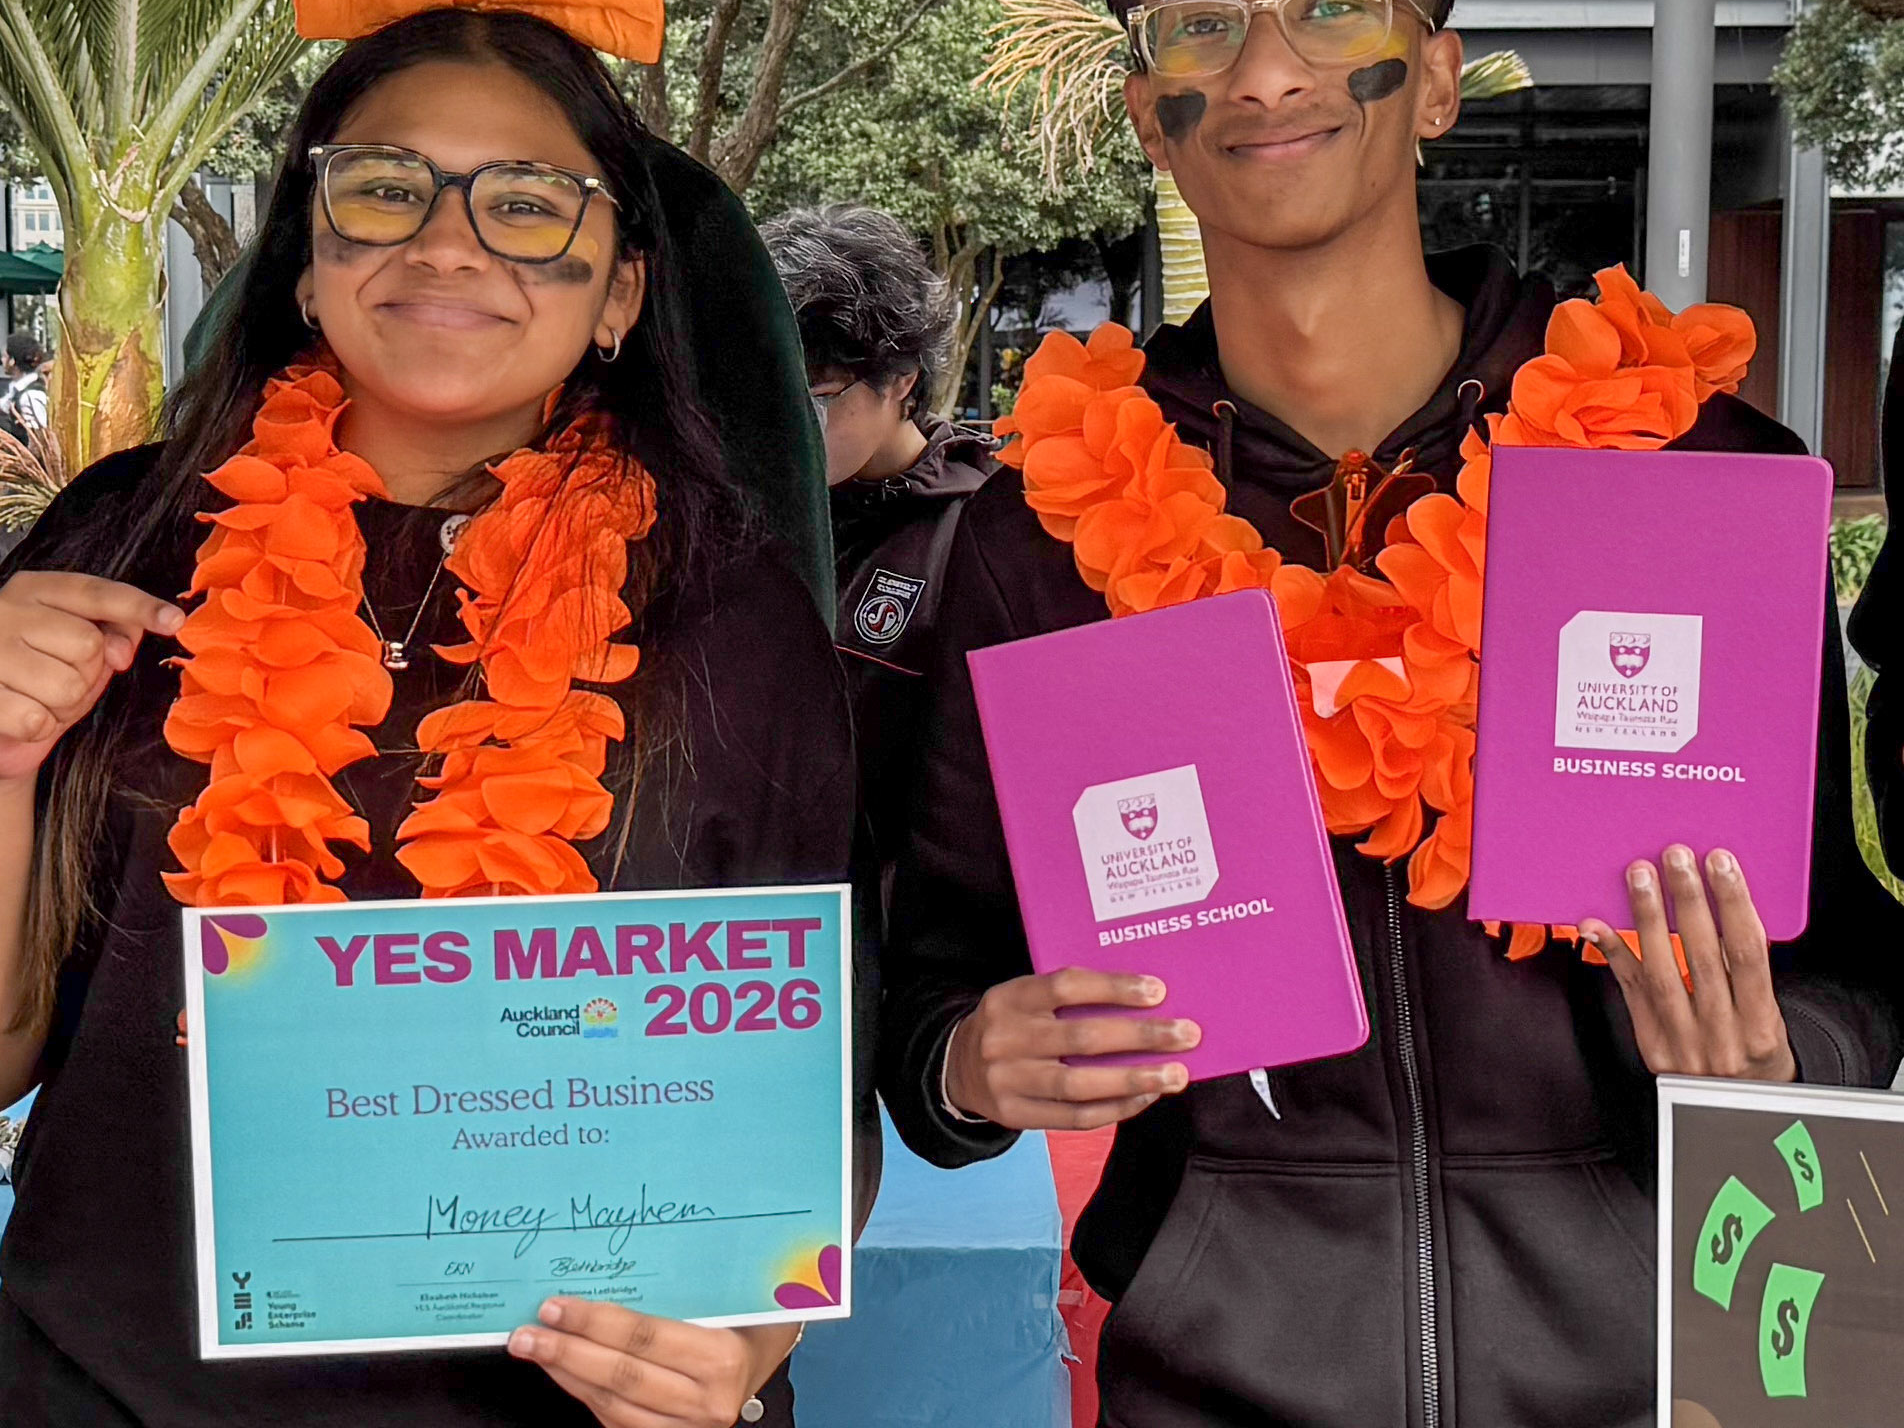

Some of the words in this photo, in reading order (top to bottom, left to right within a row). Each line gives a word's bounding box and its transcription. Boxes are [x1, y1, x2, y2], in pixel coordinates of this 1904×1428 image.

[1577, 682, 1657, 696] UNIVERSITY
[1661, 686, 1679, 697] OF
[1577, 696, 1678, 713] AUCKLAND
[1553, 758, 1656, 777] BUSINESS
[1661, 763, 1746, 782] SCHOOL
[1101, 838, 1173, 865] UNIVERSITY
[1177, 836, 1192, 848] OF
[1106, 849, 1196, 880] AUCKLAND
[1098, 914, 1193, 947] BUSINESS
[1196, 898, 1274, 926] SCHOOL
[313, 930, 472, 987] YES
[493, 917, 822, 982] MARKET
[499, 1004, 580, 1024] Auckland
[644, 978, 822, 1037] 2026
[515, 1020, 581, 1039] Council
[325, 1086, 399, 1120] Best
[412, 1079, 555, 1115] Dressed
[566, 1073, 715, 1108] Business
[452, 1124, 569, 1151] Awarded
[578, 1125, 610, 1146] to:
[426, 1194, 559, 1259] Money
[570, 1183, 714, 1259] Mayhem
